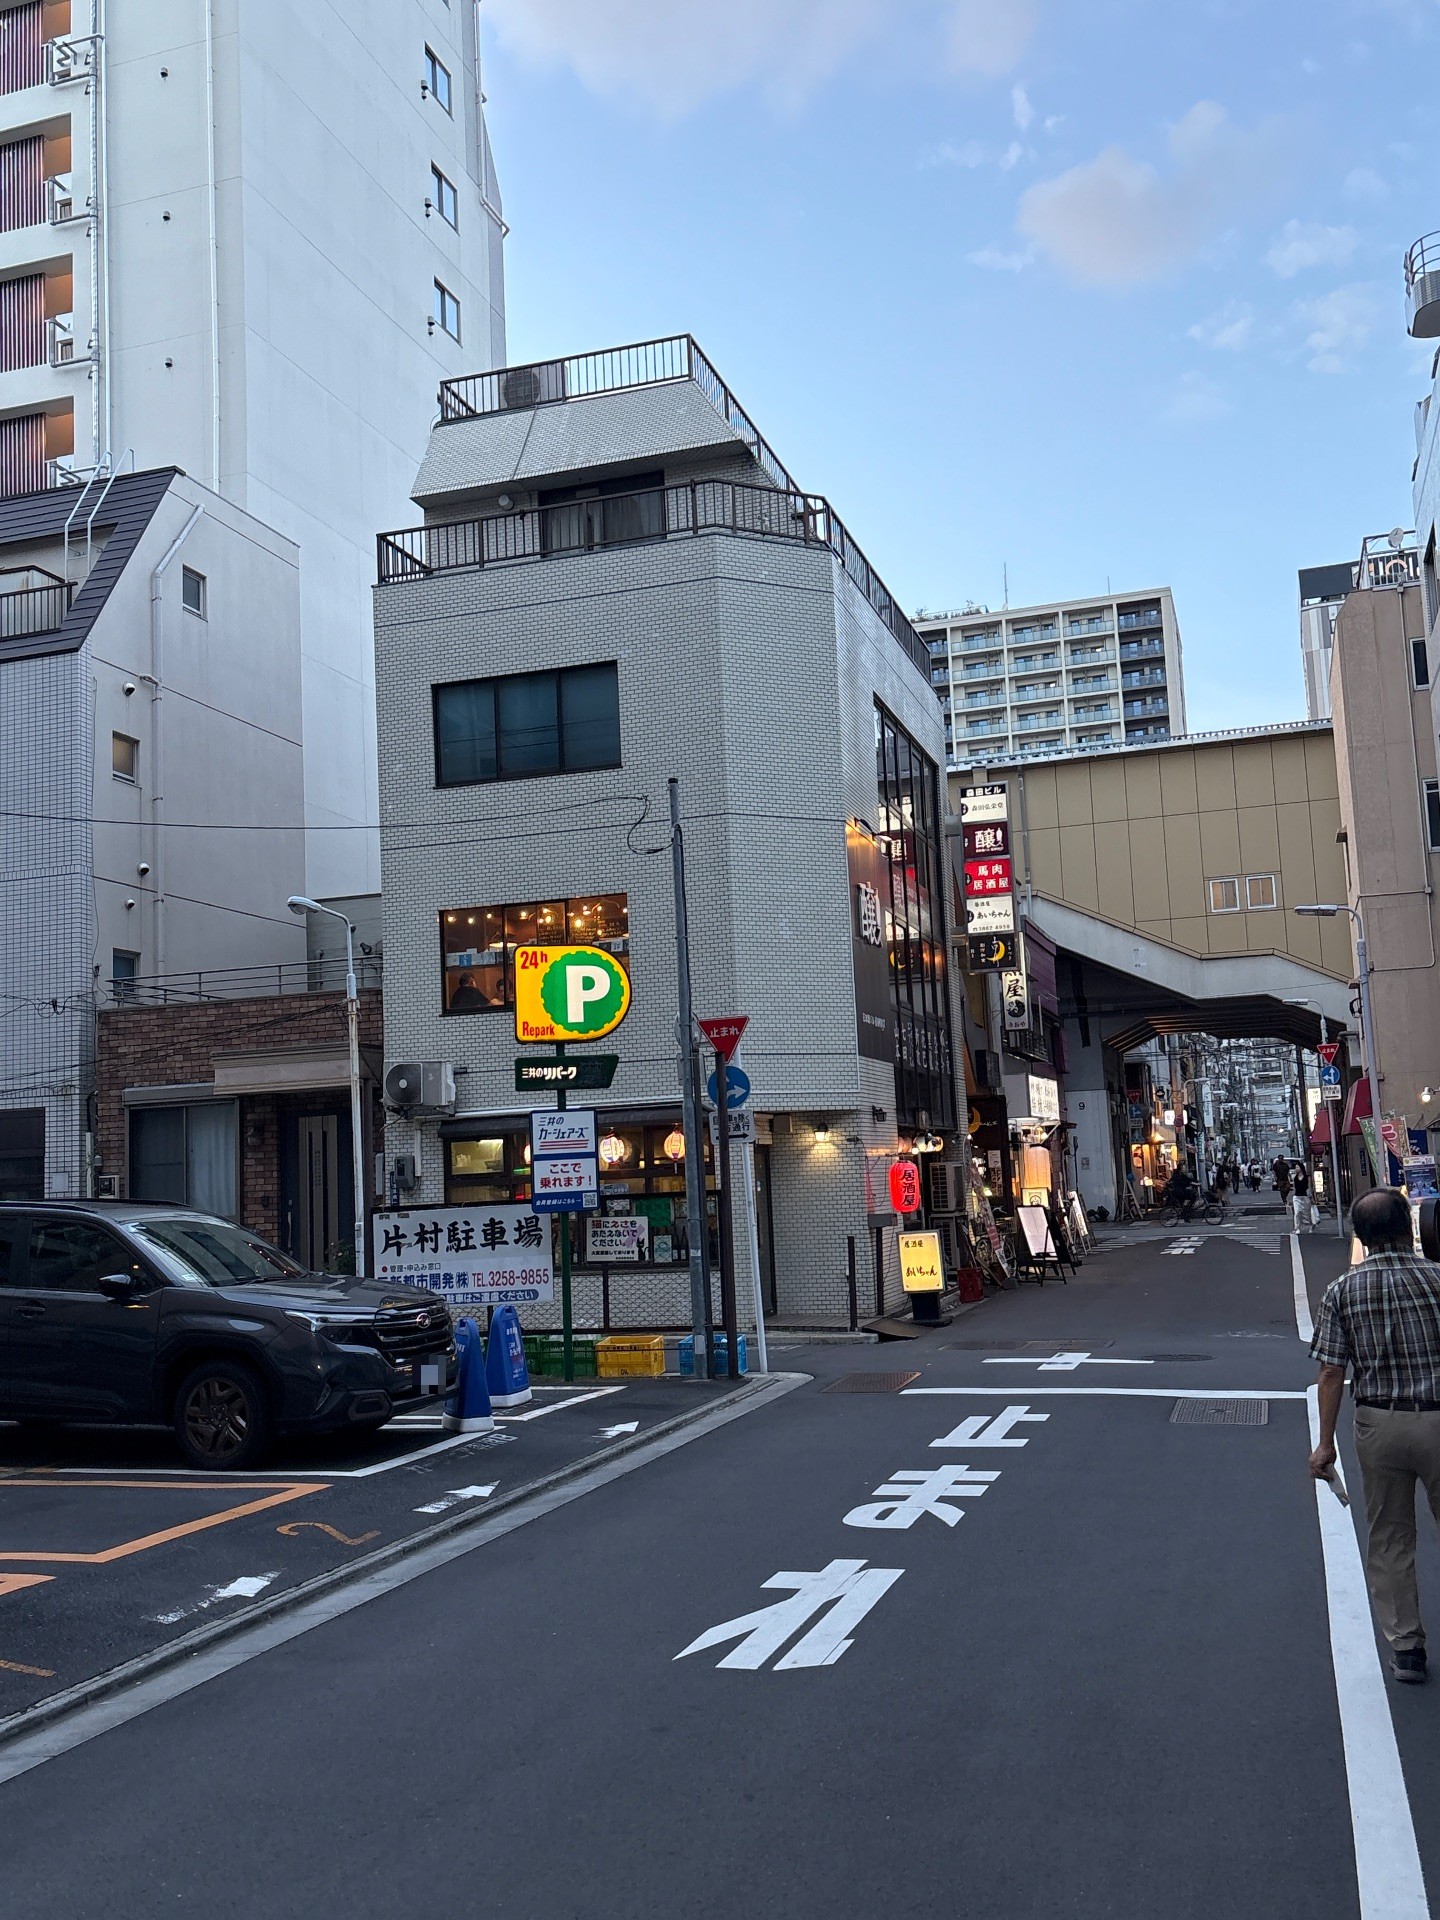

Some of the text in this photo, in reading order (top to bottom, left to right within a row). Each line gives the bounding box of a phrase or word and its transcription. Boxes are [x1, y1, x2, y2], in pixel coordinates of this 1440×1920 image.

[978, 864, 1002, 876] 馬肉
[973, 877, 1009, 890] 居酒屋
[977, 910, 1011, 919] あいちゃん
[521, 951, 548, 969] 24h
[1005, 970, 1024, 998] 屋
[566, 965, 610, 1023] P
[522, 1021, 555, 1038] Repark
[709, 1026, 740, 1038] 止まれ
[522, 1066, 577, 1080] 三井のリパーク
[1078, 1102, 1085, 1110] 9
[538, 1116, 565, 1126] 三井の
[538, 1127, 589, 1140] カーシェアーズ
[549, 1163, 581, 1174] ここで
[901, 1169, 916, 1206] 居酒屋
[591, 1220, 637, 1229] 猫にえさを
[381, 1215, 543, 1257] 片村駐車場
[591, 1229, 637, 1238] あたえないで
[906, 1265, 937, 1277] あいちゃん
[276, 1521, 381, 1546] 2
[672, 1405, 1051, 1671] 止まれ
